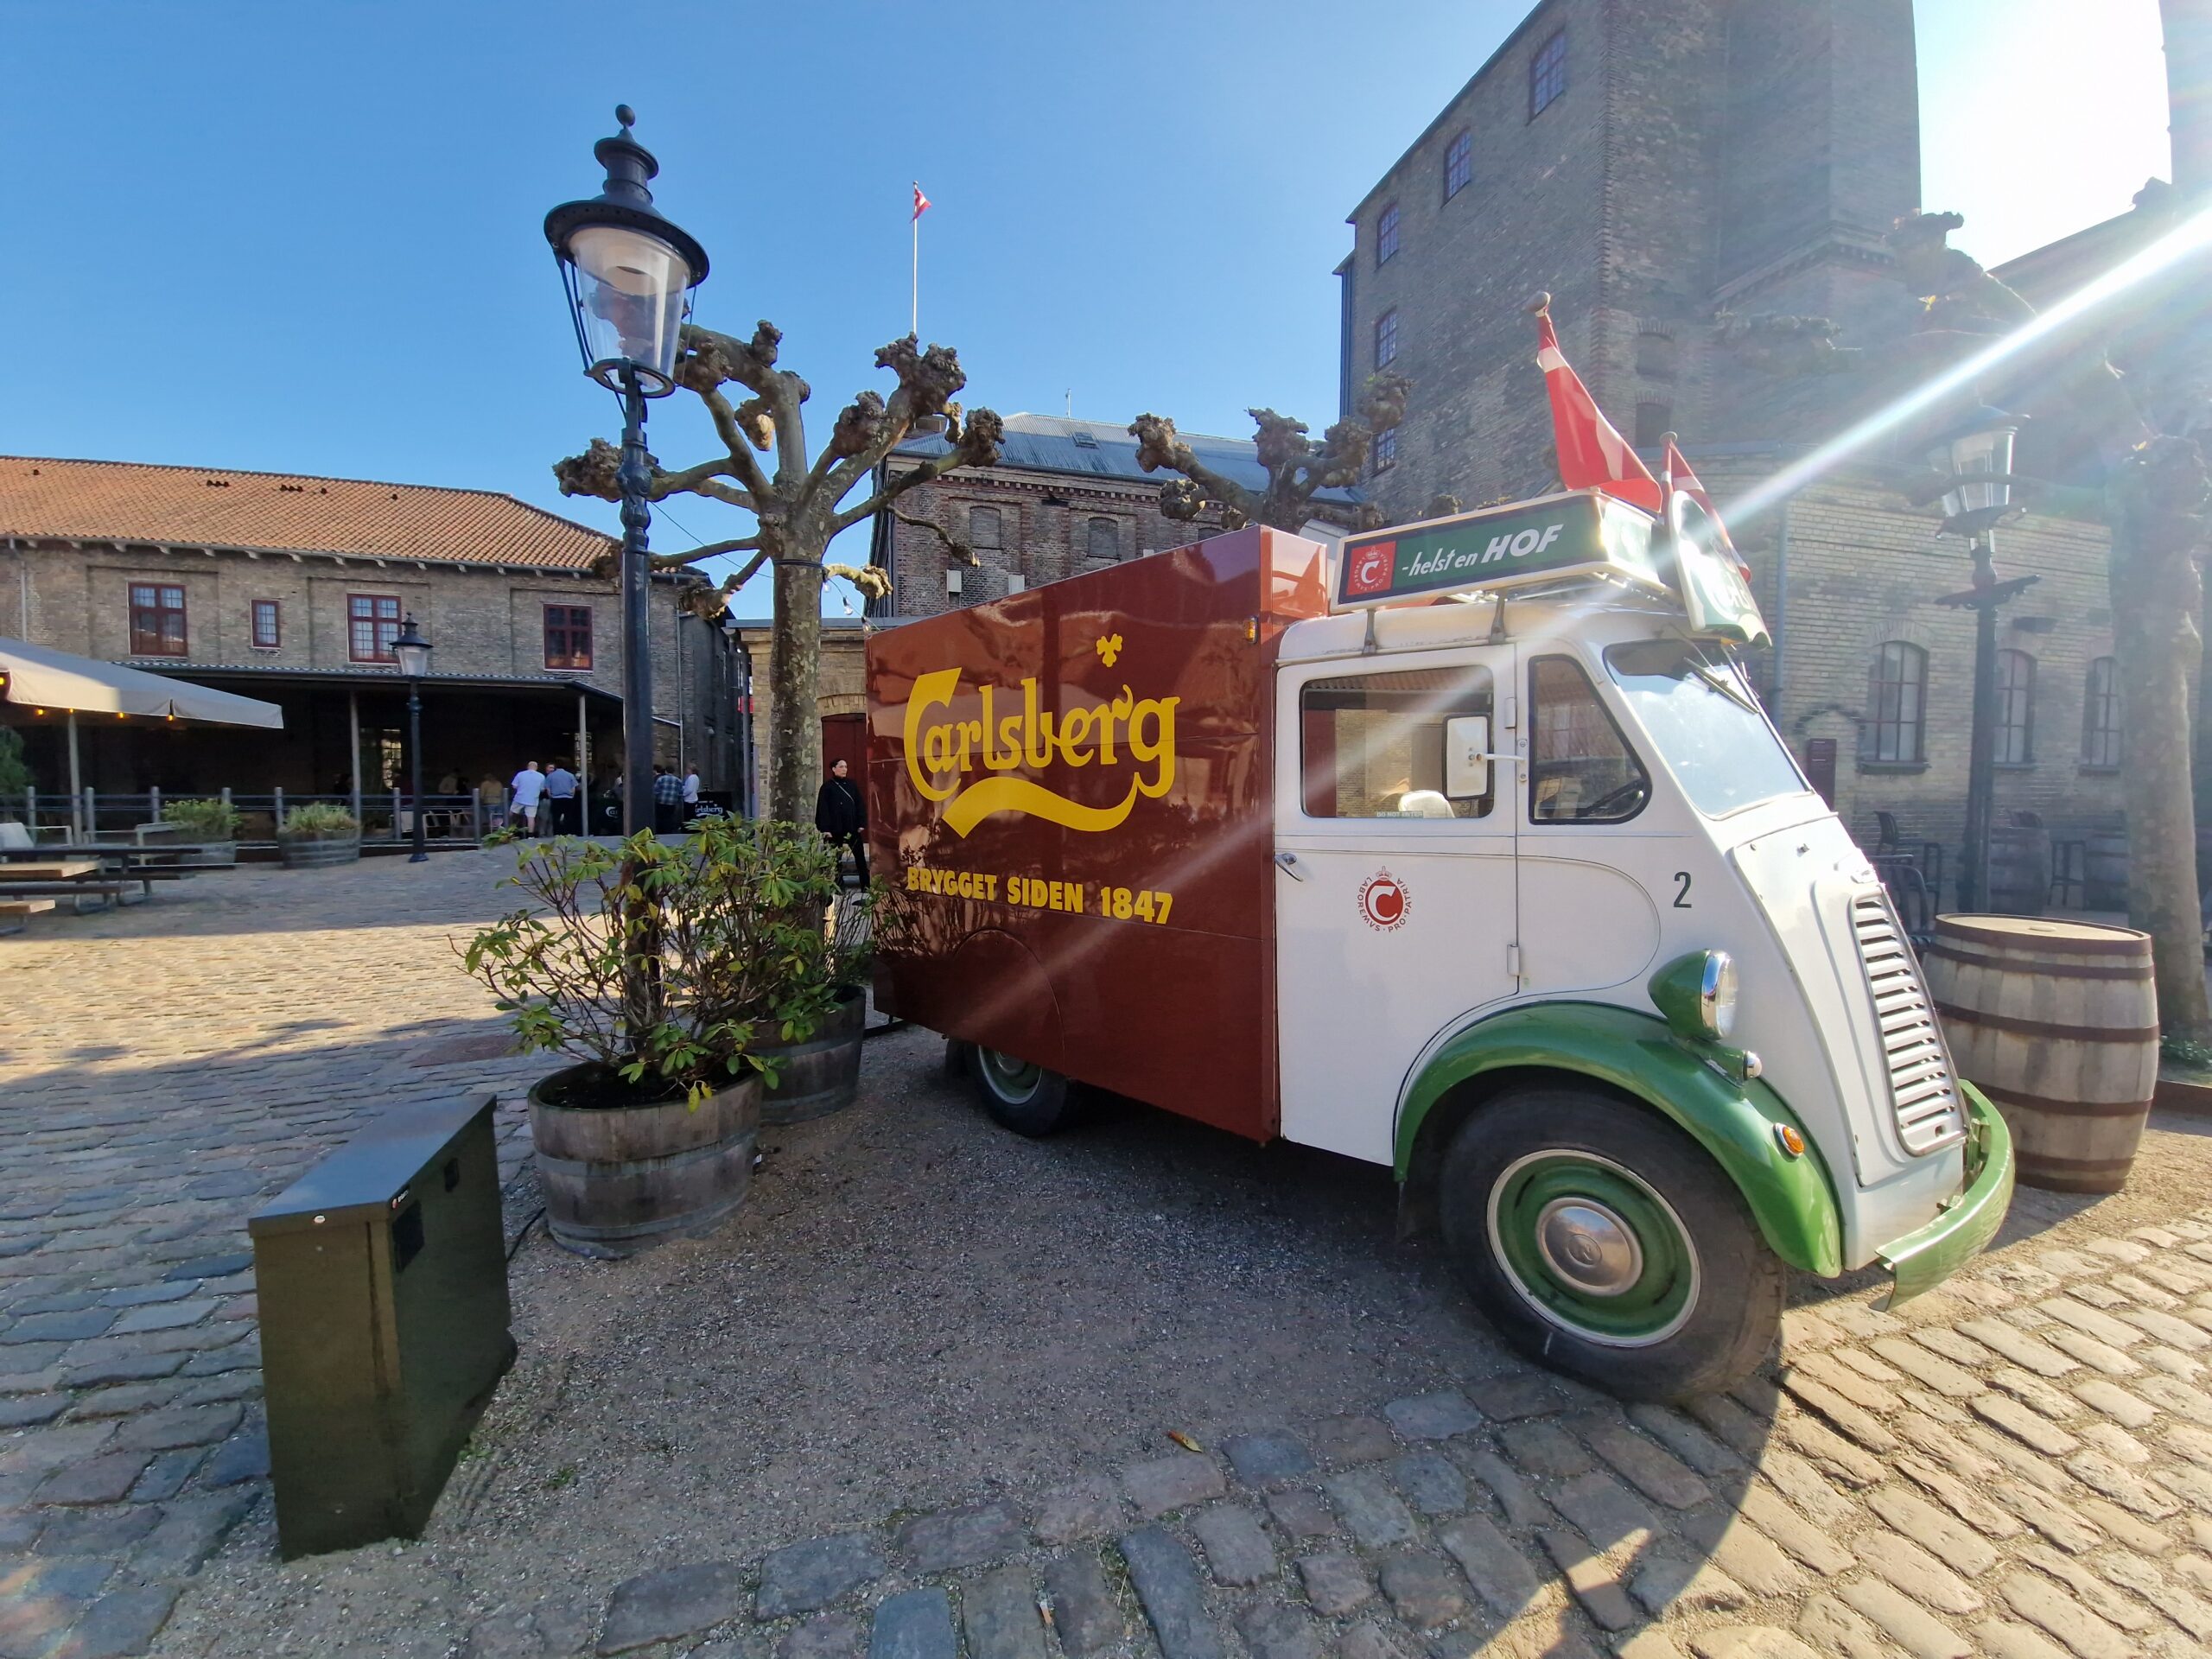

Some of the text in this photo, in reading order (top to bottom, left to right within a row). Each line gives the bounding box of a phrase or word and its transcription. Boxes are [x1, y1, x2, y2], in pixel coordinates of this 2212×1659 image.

[1454, 552, 1478, 568] en
[1481, 524, 1564, 563] HOF
[904, 667, 1181, 839] Carlsberg
[906, 867, 1173, 925] BRYGGET SIDEN 1847
[1396, 878, 1412, 915] PATRIA
[1673, 871, 1693, 908] 2
[1388, 918, 1406, 933] PRO
